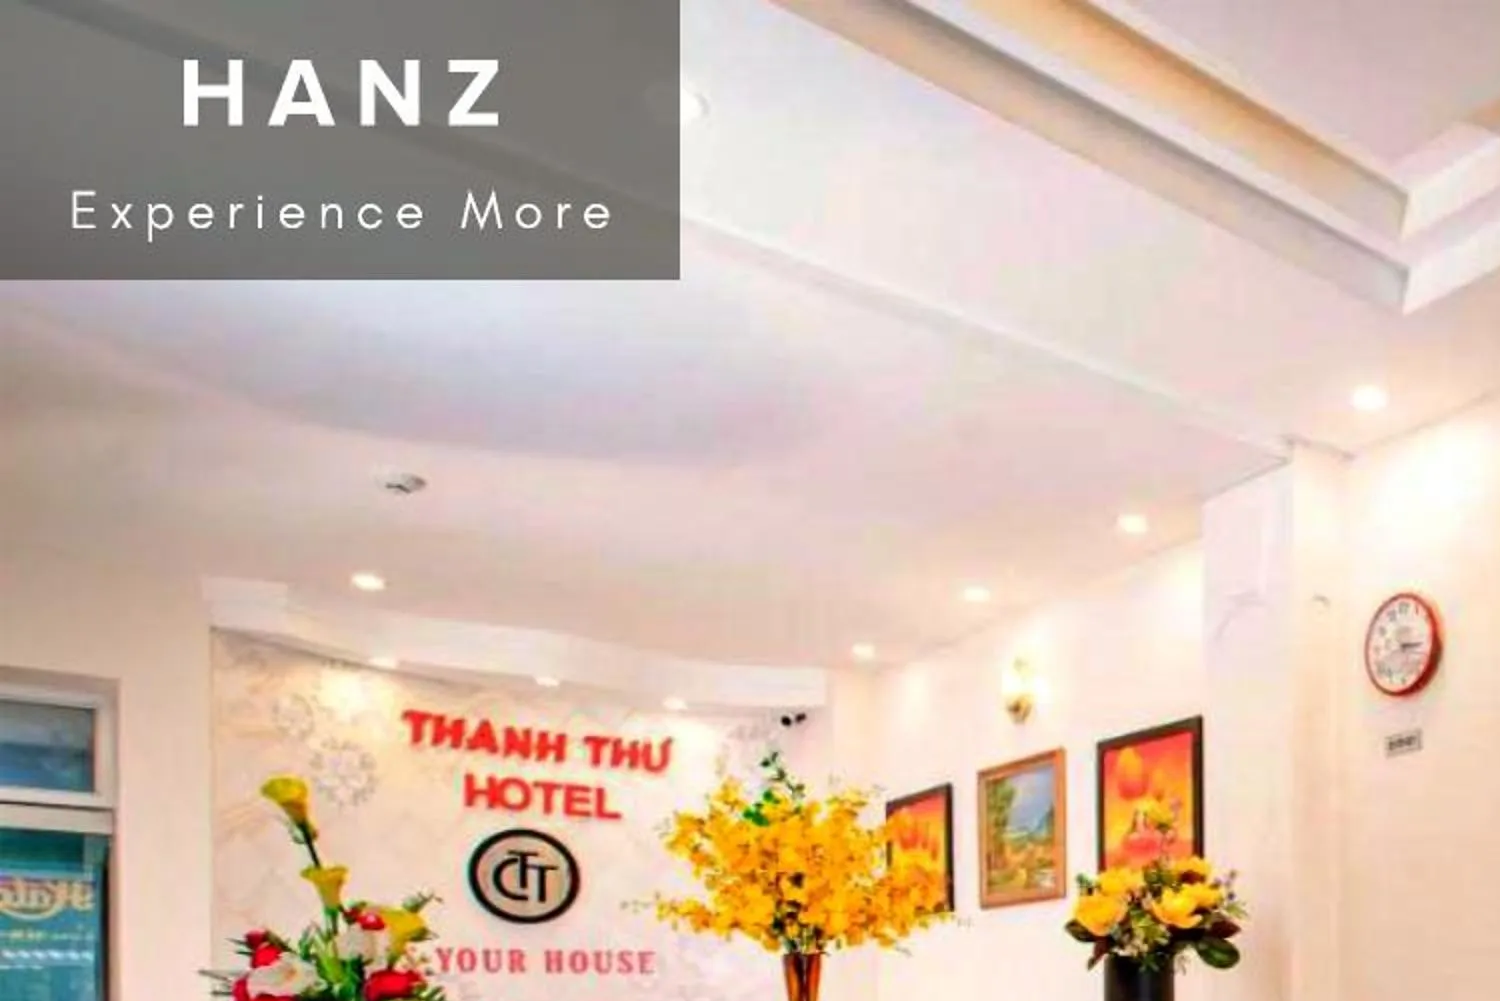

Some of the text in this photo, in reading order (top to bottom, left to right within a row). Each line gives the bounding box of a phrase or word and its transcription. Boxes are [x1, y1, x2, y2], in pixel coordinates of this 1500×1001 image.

[402, 709, 567, 763] THANH
[464, 772, 623, 821] HOTEL
[434, 947, 656, 974] YOUR HOUSE
